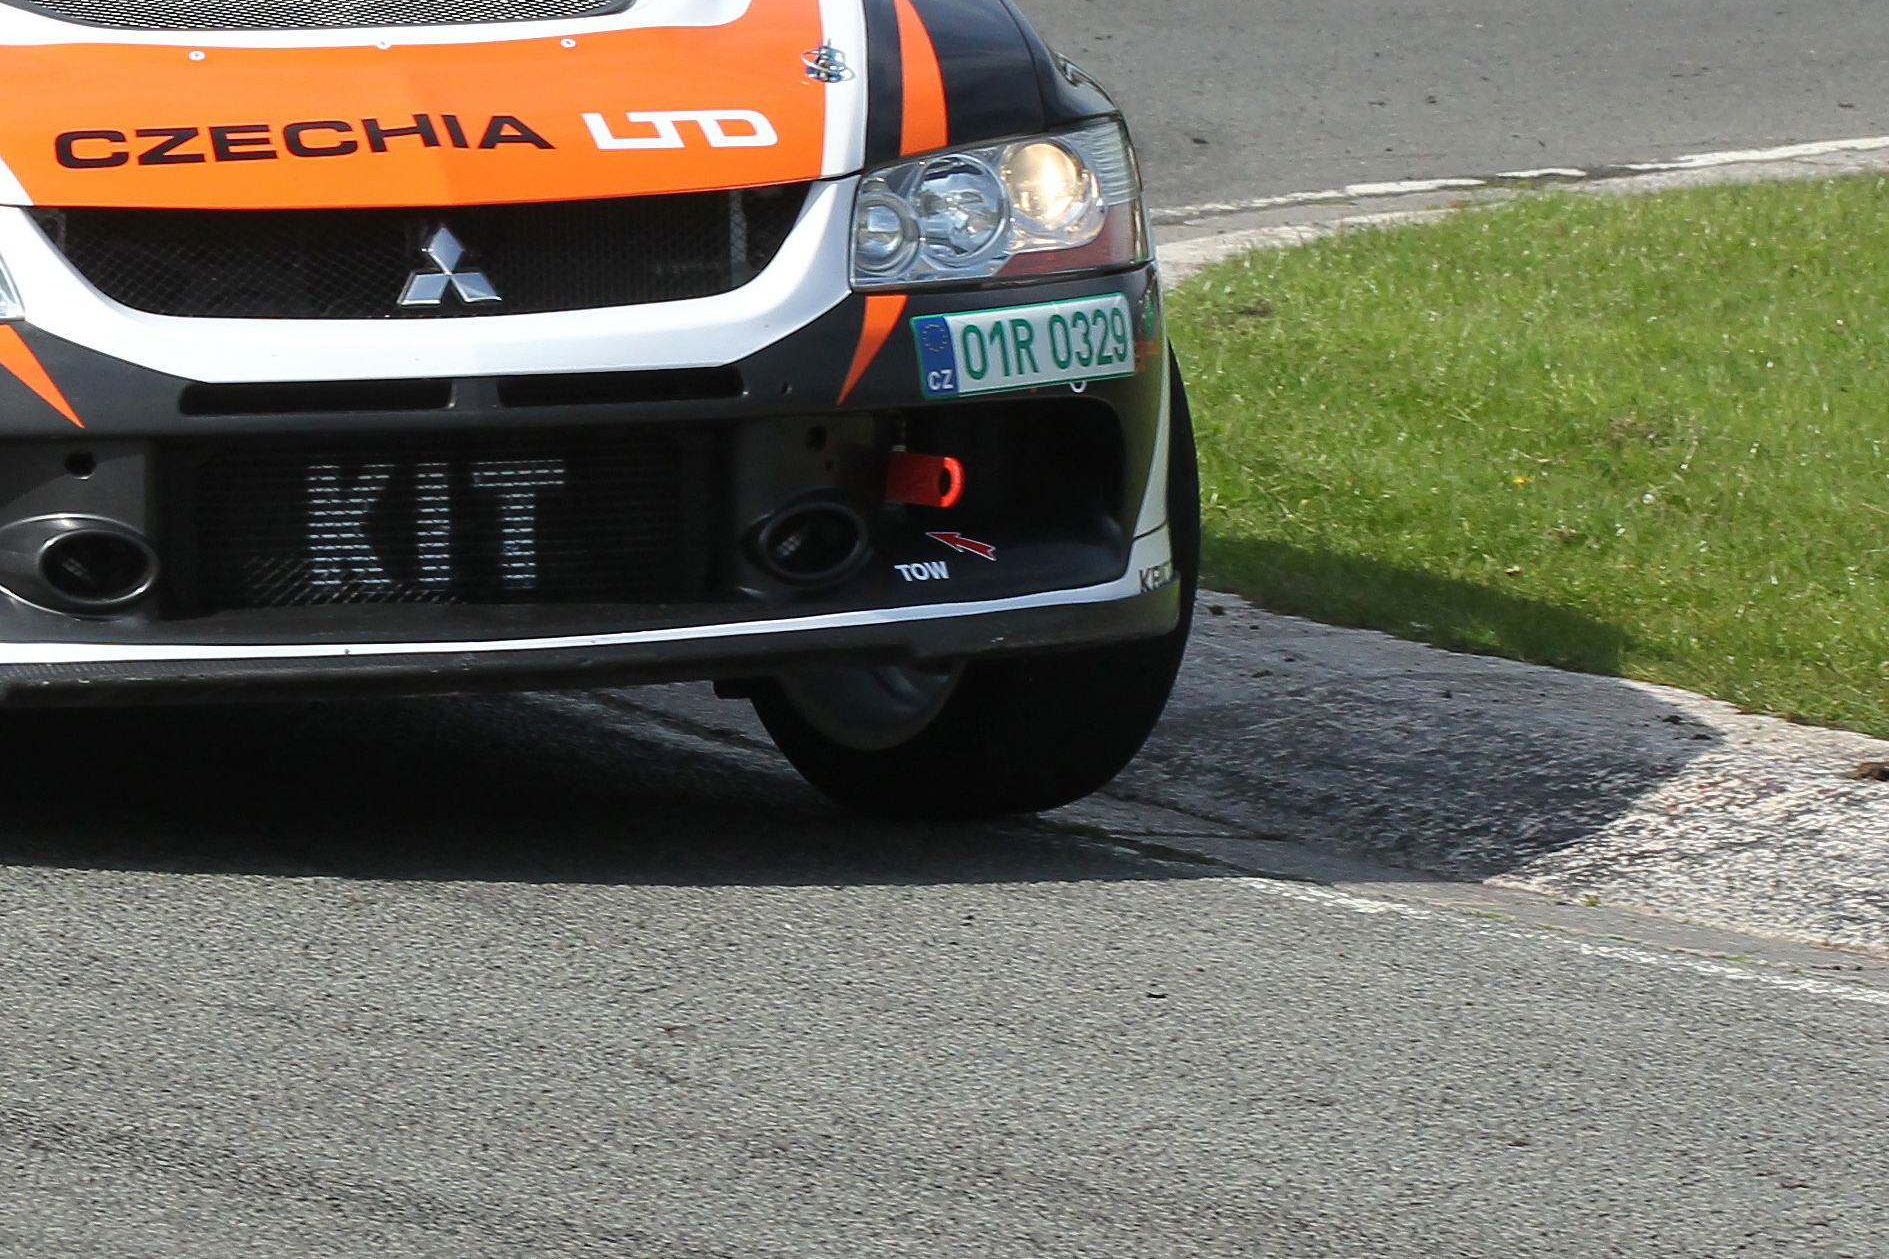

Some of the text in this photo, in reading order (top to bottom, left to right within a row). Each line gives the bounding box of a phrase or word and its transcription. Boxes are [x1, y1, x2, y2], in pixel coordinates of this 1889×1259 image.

[53, 108, 780, 169] CZECHIA LTD
[961, 306, 1129, 381] 01R 0329
[927, 368, 954, 391] CZ
[307, 458, 566, 590] KIT
[893, 560, 950, 582] TOW
